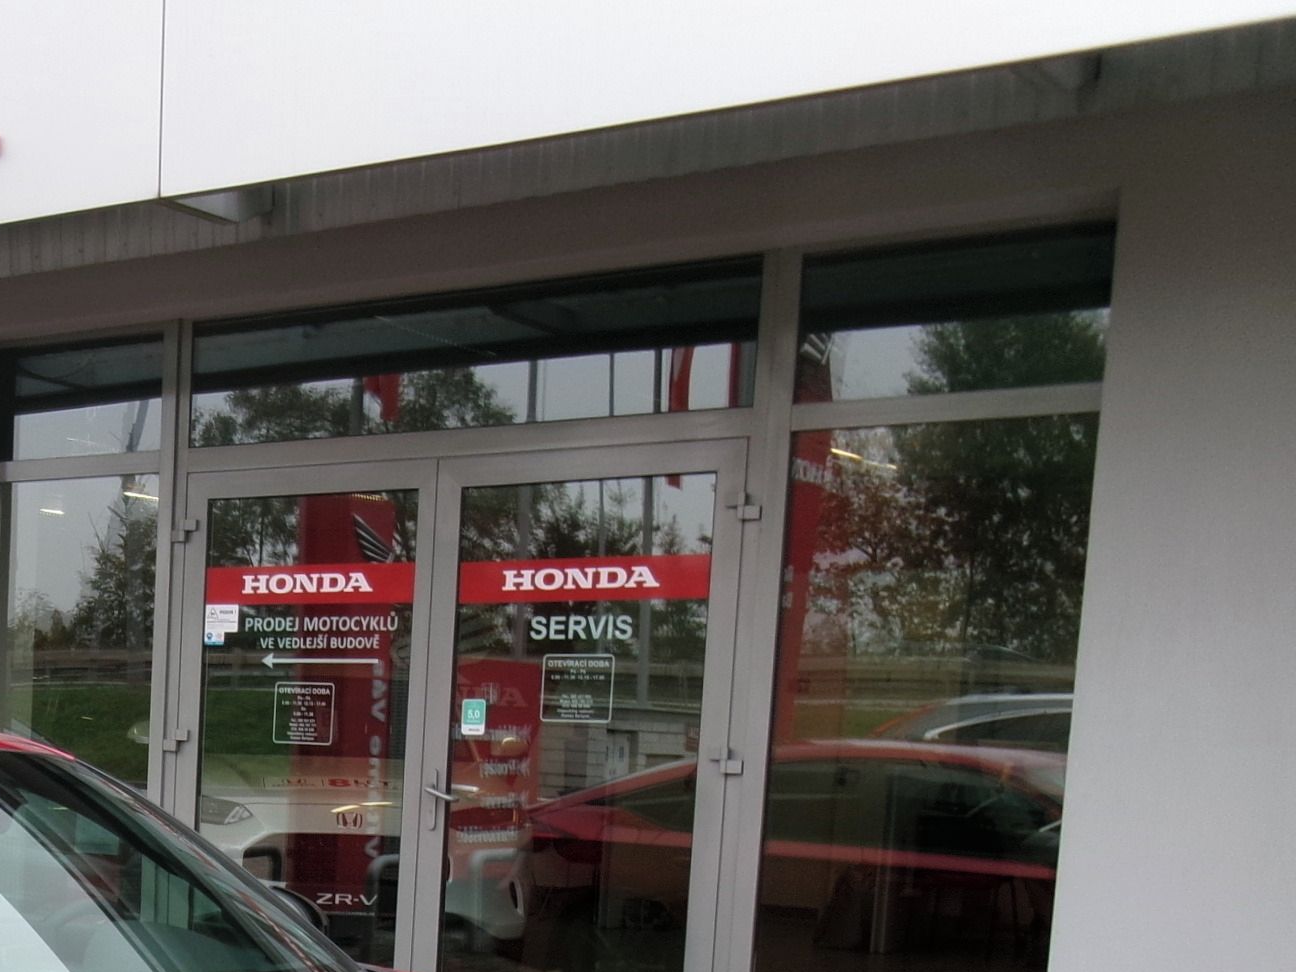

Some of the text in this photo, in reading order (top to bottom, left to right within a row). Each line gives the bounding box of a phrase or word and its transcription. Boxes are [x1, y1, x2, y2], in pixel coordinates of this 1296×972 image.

[241, 571, 374, 595] HONDA
[501, 565, 661, 592] HONDA
[244, 616, 300, 633] PRODEJ
[303, 610, 399, 633] MOTOCYKLŮ
[529, 613, 634, 641] SERVIS
[260, 633, 381, 650] VE VEDLEJŠÍ BUDOVĚ
[587, 659, 610, 668] DOBA
[312, 687, 331, 696] DOBA
[467, 709, 481, 721] 5,0
[316, 892, 378, 906] ZR-V
